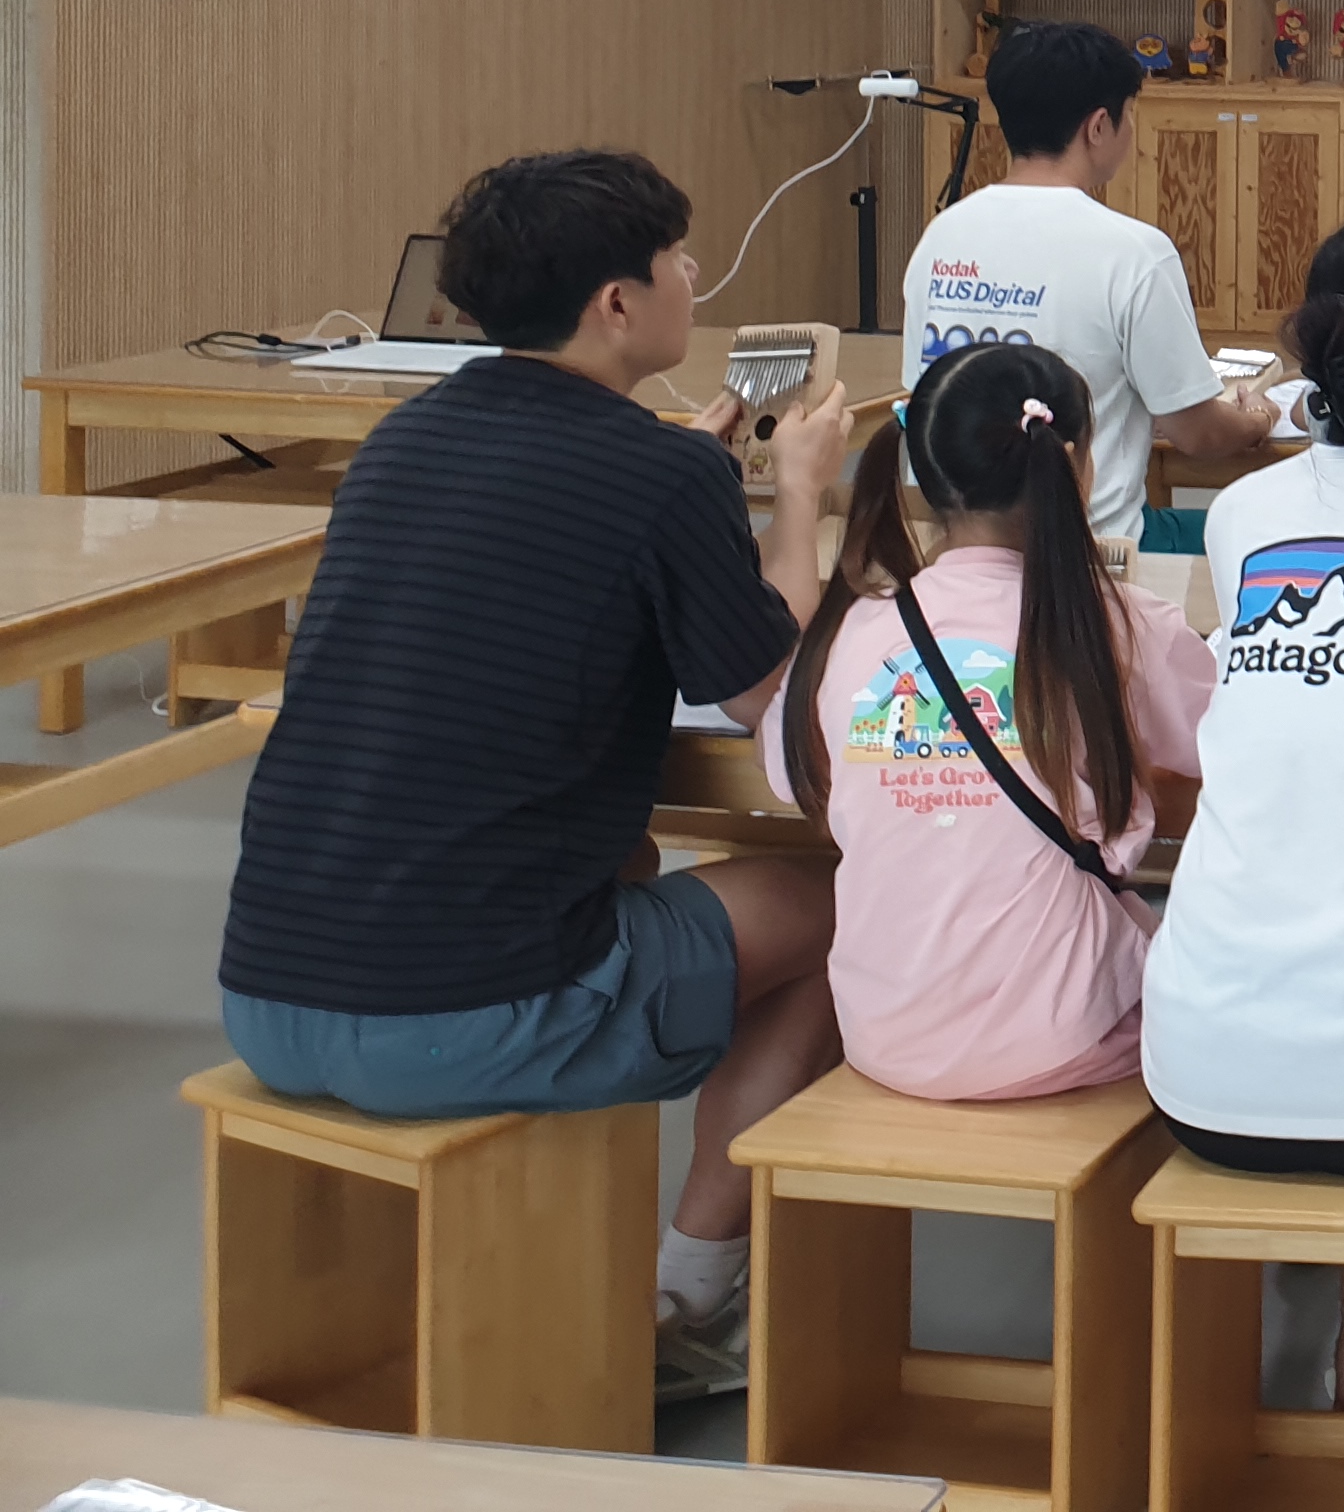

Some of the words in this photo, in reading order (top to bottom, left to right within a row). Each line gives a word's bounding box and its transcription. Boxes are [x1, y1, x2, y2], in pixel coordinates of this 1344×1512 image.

[931, 258, 980, 278] Kodak
[928, 279, 973, 300] PLUS
[973, 282, 1047, 308] Digital
[879, 766, 934, 787] Let's
[891, 789, 1000, 814] Together
